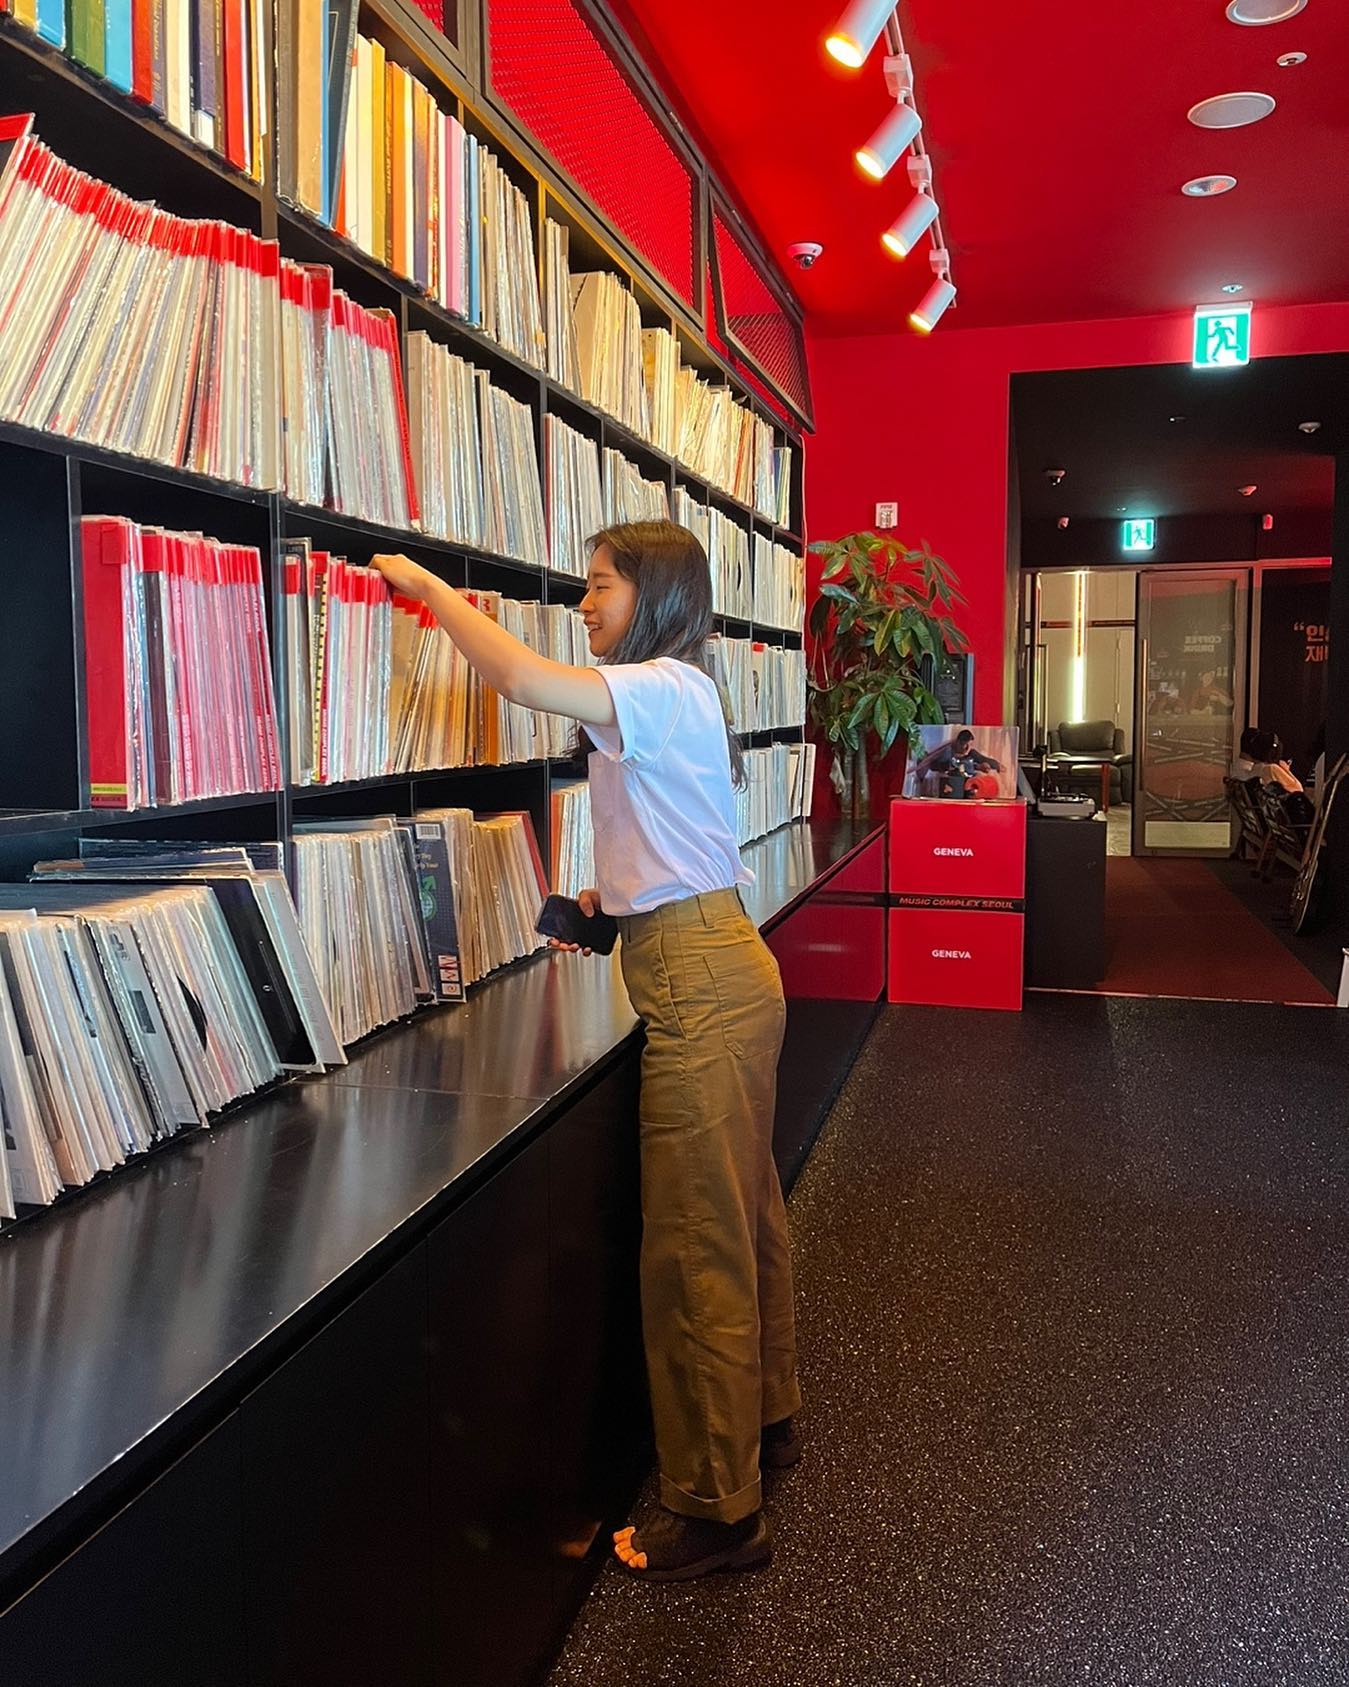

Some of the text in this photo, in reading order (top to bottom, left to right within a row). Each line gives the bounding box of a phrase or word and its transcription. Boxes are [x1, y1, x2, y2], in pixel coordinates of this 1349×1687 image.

[933, 847, 974, 857] GENEVA
[899, 897, 1014, 909] MUSIC COMPLEX SEOUL
[932, 949, 972, 959] GENEVA
